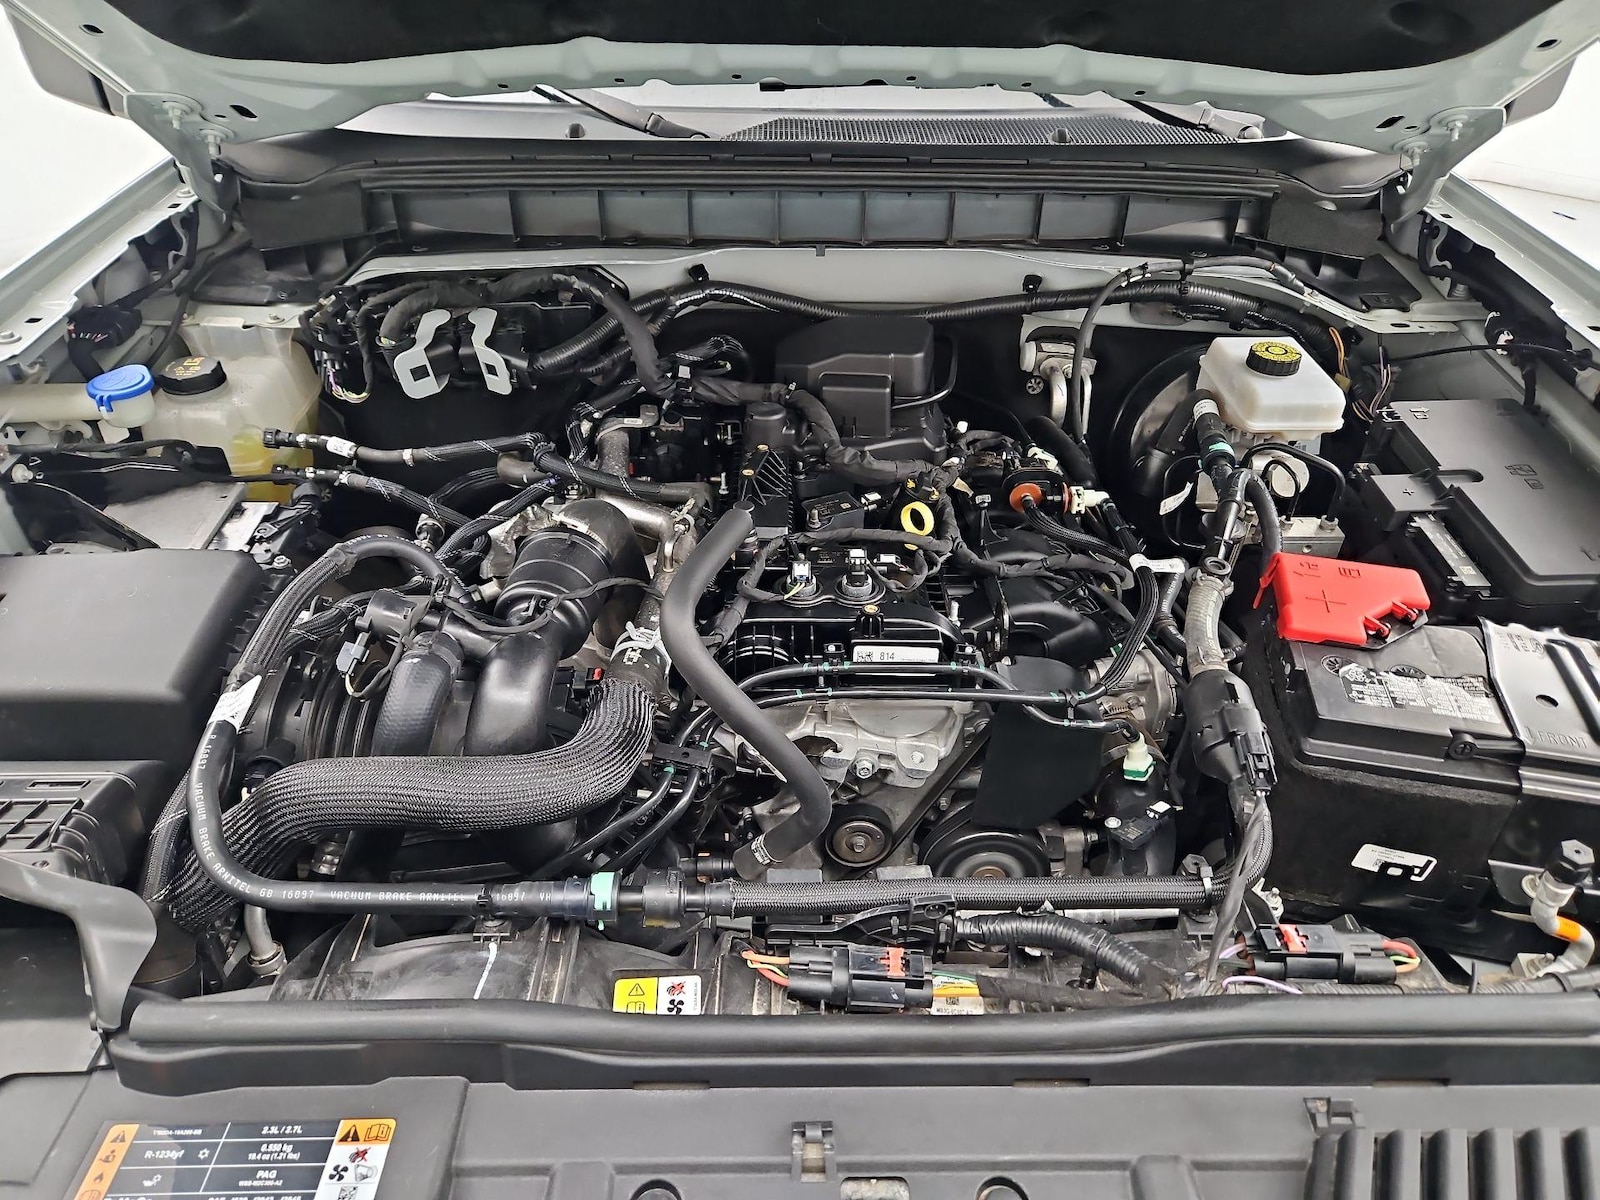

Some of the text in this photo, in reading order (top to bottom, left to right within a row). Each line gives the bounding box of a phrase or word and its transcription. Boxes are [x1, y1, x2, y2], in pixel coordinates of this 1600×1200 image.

[879, 651, 895, 661] 814
[1537, 730, 1588, 749] FRONT
[194, 782, 207, 820] VACUUM
[198, 827, 215, 861] BRAKE
[282, 889, 314, 900] 16897
[330, 891, 371, 901] VACUUM
[379, 891, 412, 901] BRAKE
[144, 1149, 185, 1160] R-1234yf
[256, 1169, 277, 1179] PAG
